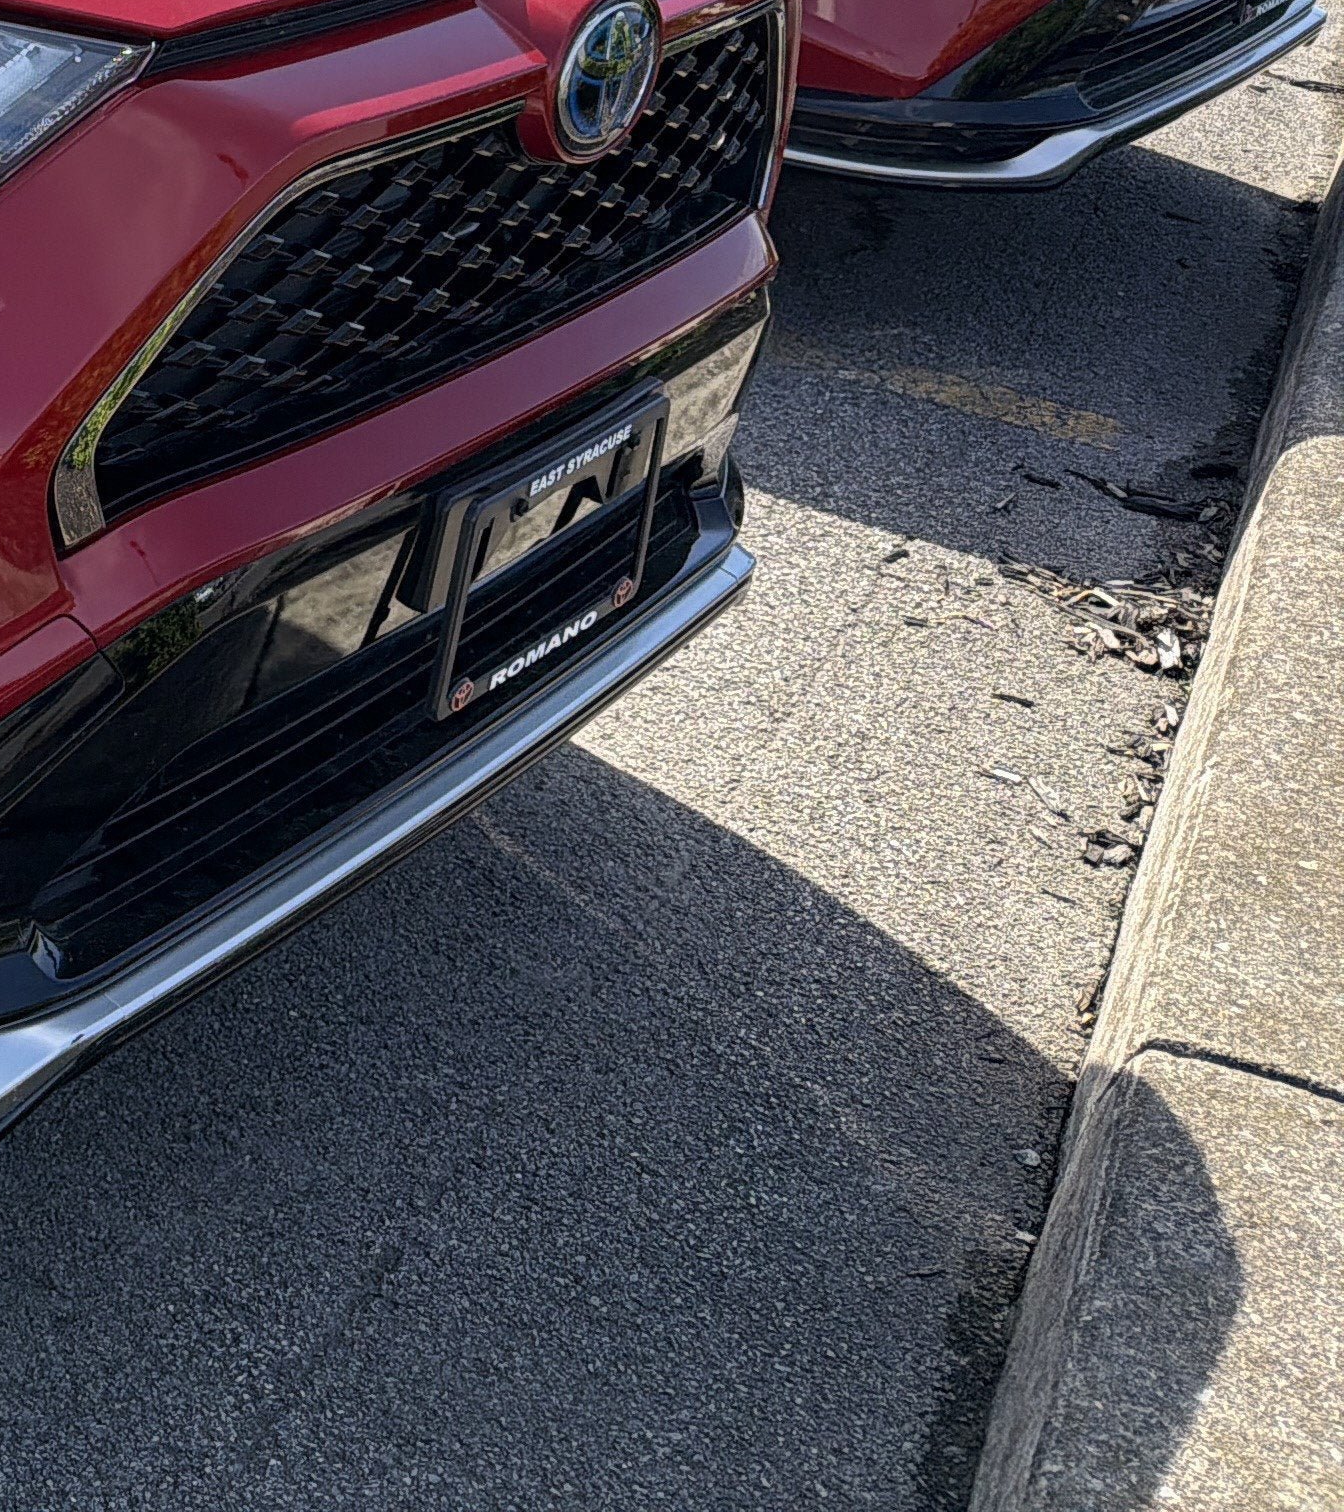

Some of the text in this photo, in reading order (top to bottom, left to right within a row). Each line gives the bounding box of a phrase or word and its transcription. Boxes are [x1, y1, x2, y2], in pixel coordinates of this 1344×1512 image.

[530, 424, 633, 497] EAST SYRACUSE
[489, 609, 598, 691] ROMANO
